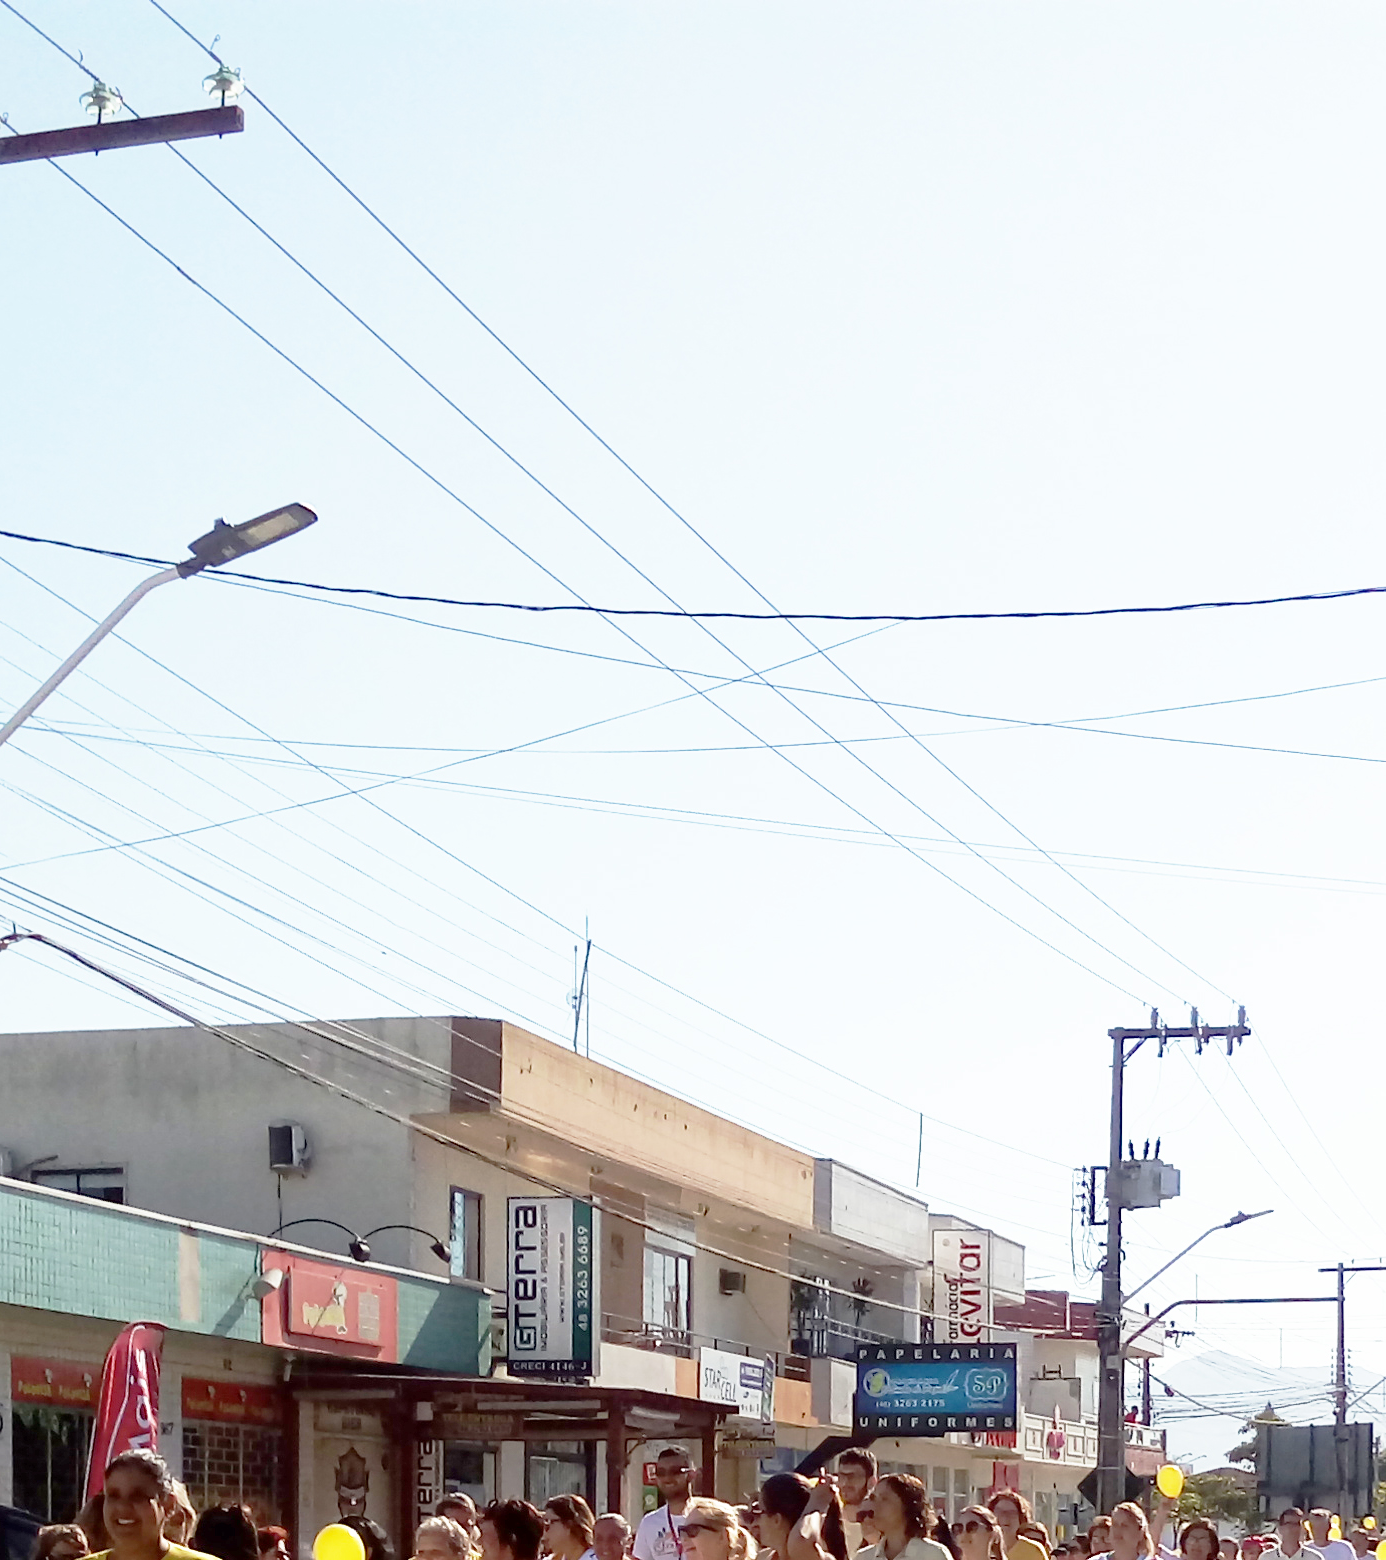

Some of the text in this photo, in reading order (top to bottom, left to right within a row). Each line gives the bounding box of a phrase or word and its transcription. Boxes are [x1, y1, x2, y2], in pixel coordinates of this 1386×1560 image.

[577, 1225, 589, 1332] 48 3263 6689
[858, 1347, 1014, 1360] PAPELARIA
[513, 1361, 546, 1371] CRECI
[859, 1416, 1014, 1428] UNIFORMES
